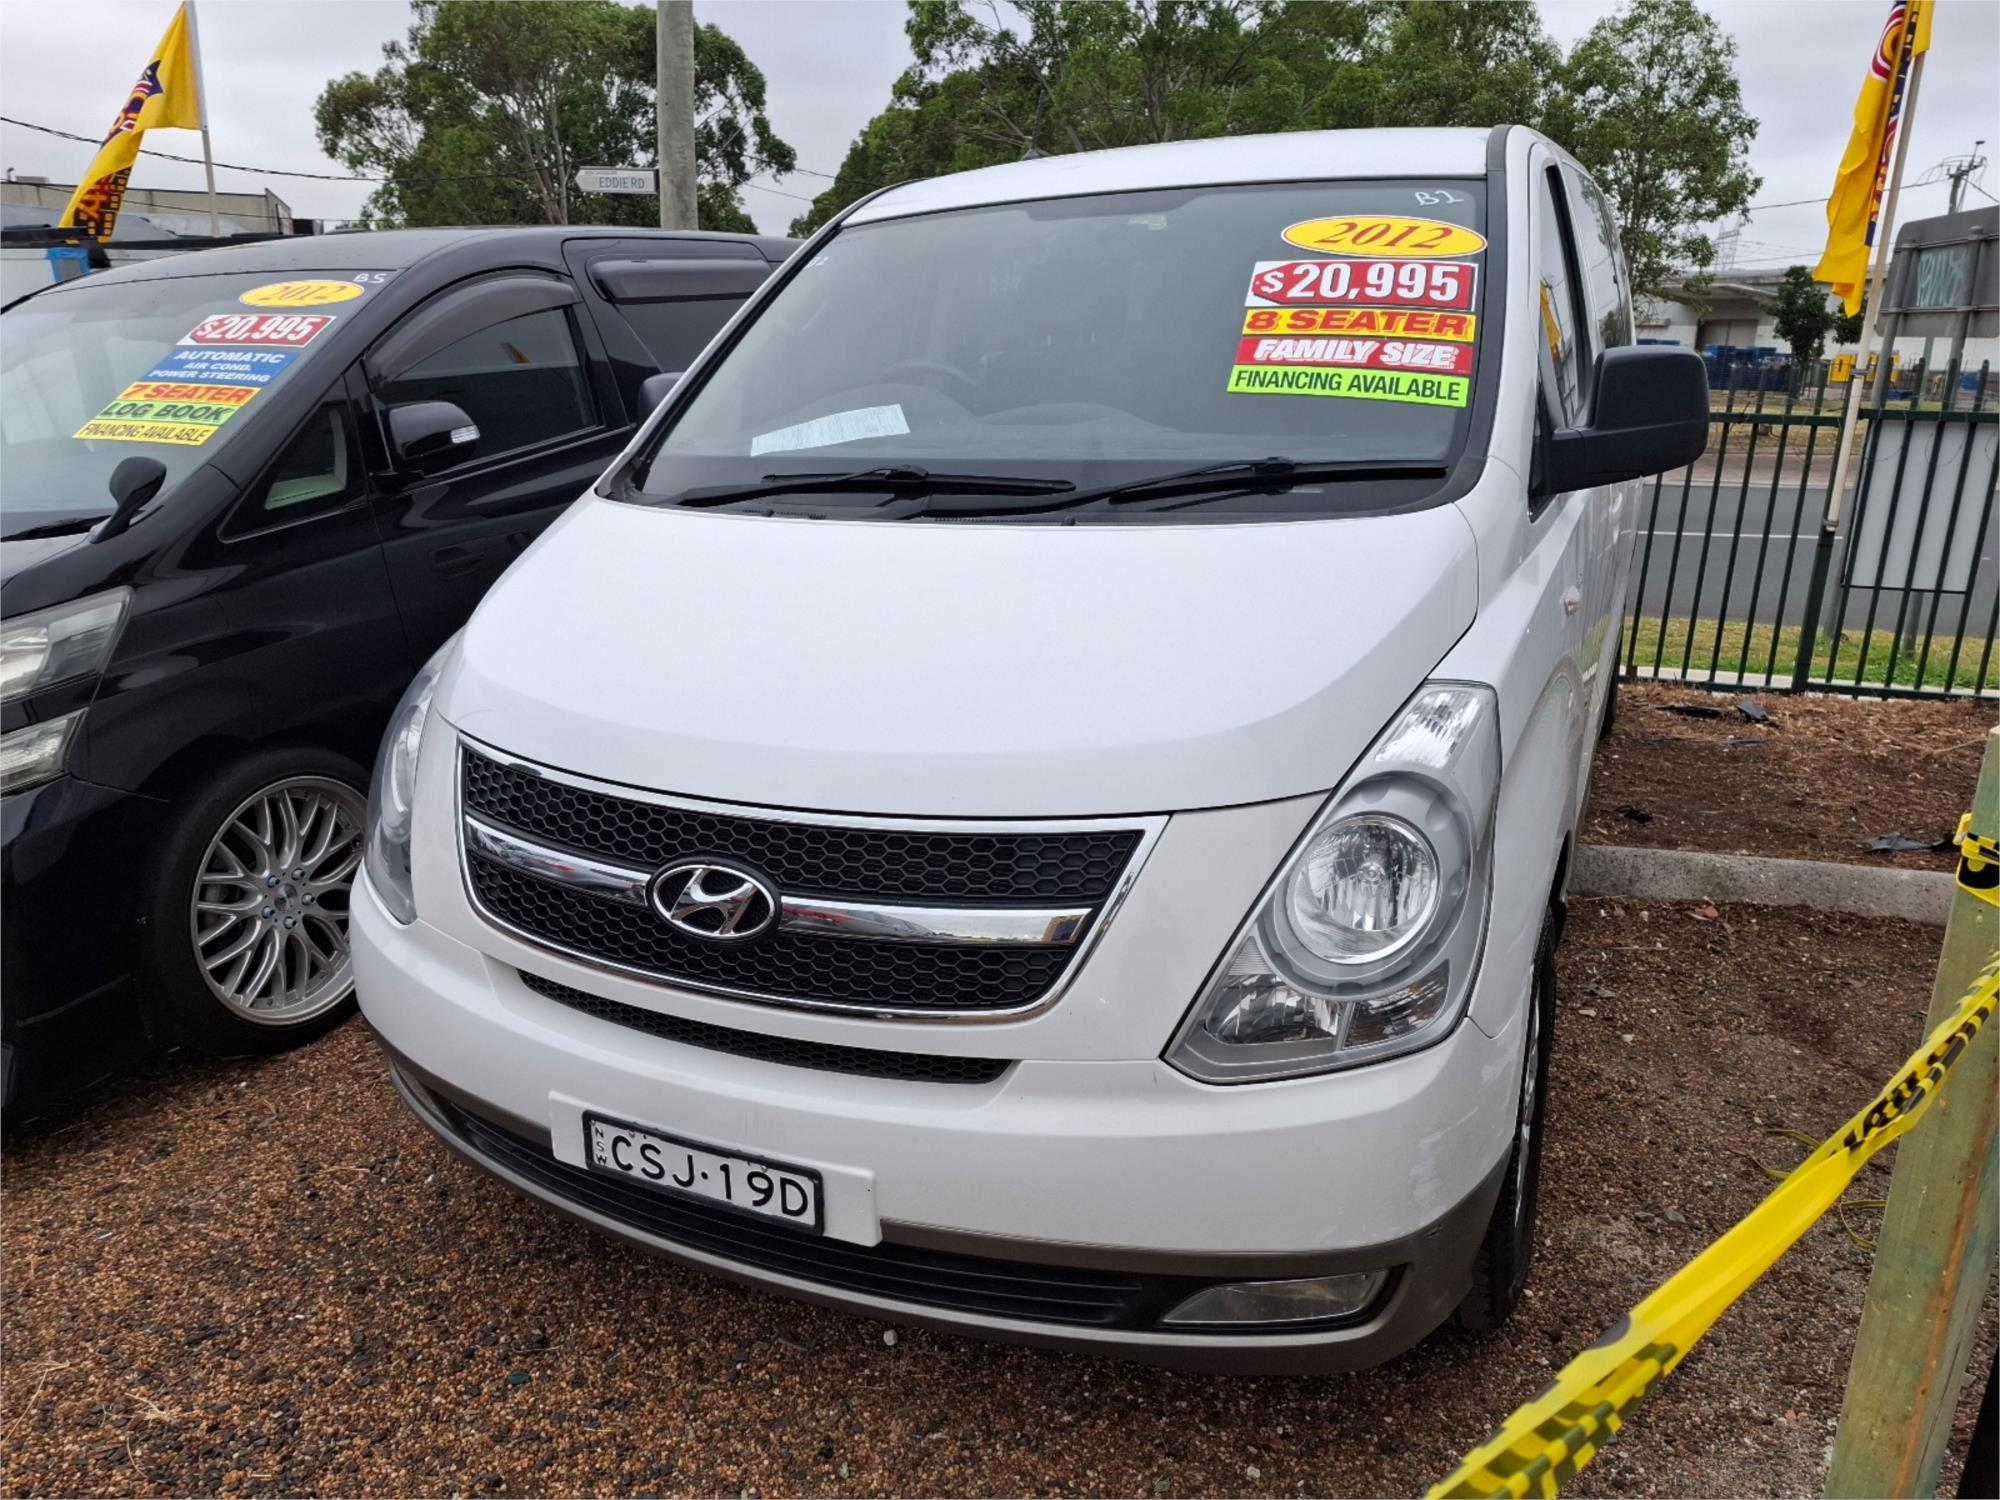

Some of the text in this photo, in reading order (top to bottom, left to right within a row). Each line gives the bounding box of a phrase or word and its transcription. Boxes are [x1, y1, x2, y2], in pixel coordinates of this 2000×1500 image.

[599, 176, 645, 189] EDDIE RD
[1314, 221, 1453, 249] 2012
[1260, 263, 1460, 302] $20,995
[257, 285, 347, 301] 2012
[196, 315, 322, 341] $20,995
[1246, 310, 1470, 337] 8 SEATER
[174, 350, 286, 364] AUTOMATIC
[1253, 338, 1460, 370] FAMILY SIZE
[149, 369, 270, 383] POWER STEERING
[183, 361, 251, 372] AIR COND.
[121, 384, 254, 404] 7 SEATER
[1234, 370, 1462, 401] FINANCING AVAILABLE
[101, 402, 232, 421] LOG BOOK
[80, 423, 211, 442] FINANCING AVAILABLE
